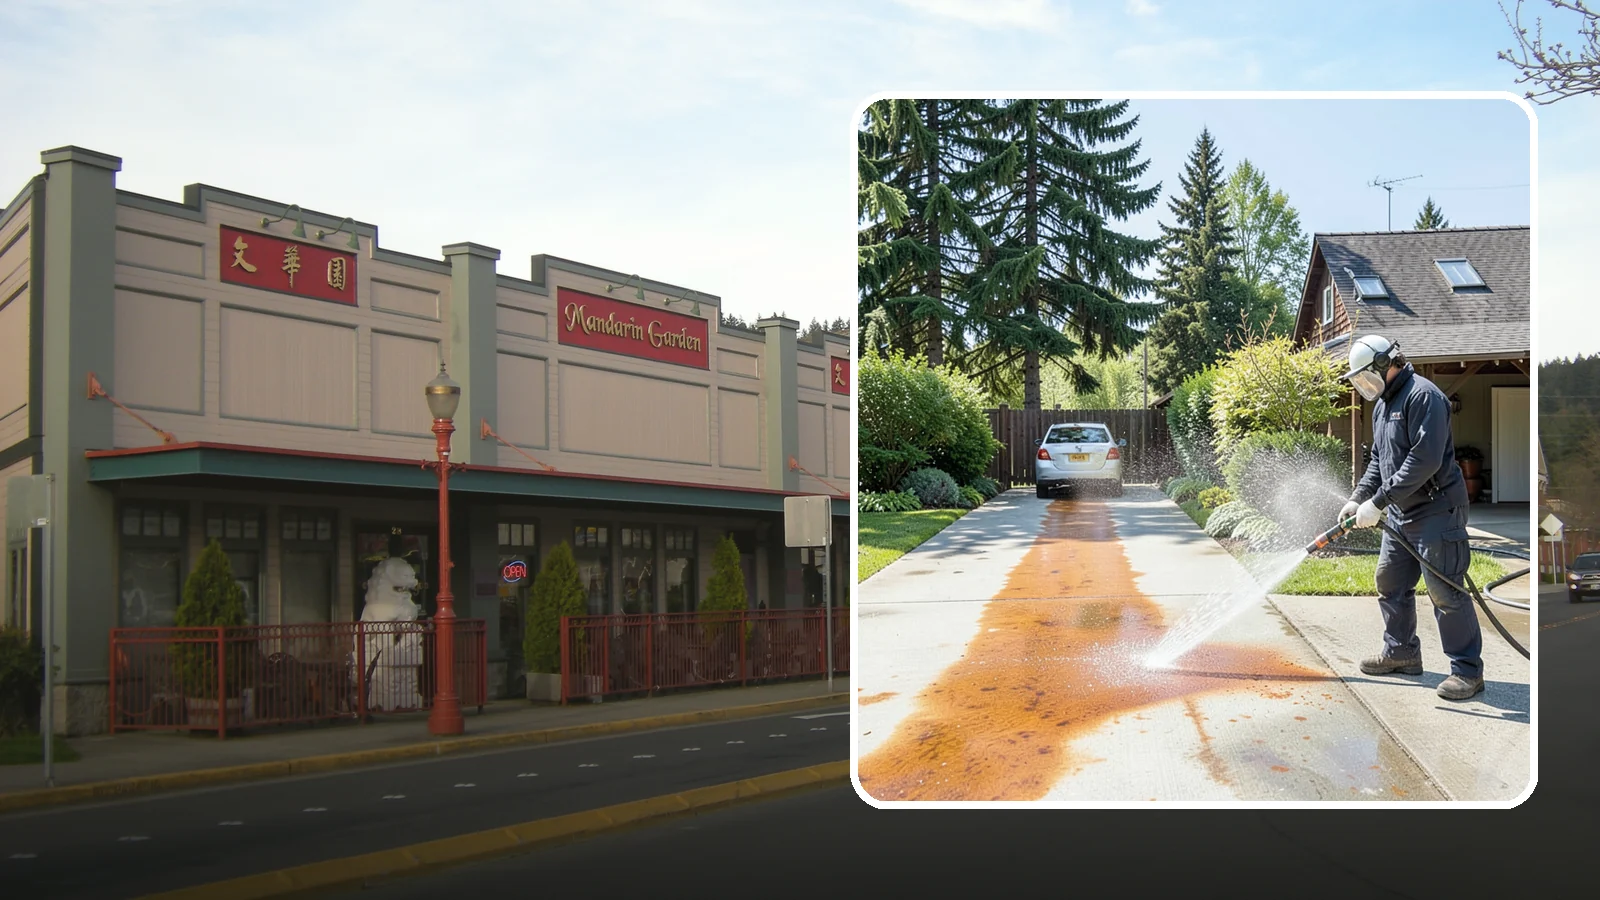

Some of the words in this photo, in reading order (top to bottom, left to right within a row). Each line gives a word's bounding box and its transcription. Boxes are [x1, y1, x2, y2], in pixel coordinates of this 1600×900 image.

[564, 302, 644, 341] Mandarin
[648, 320, 701, 352] Garden
[503, 565, 526, 578] OPEN
